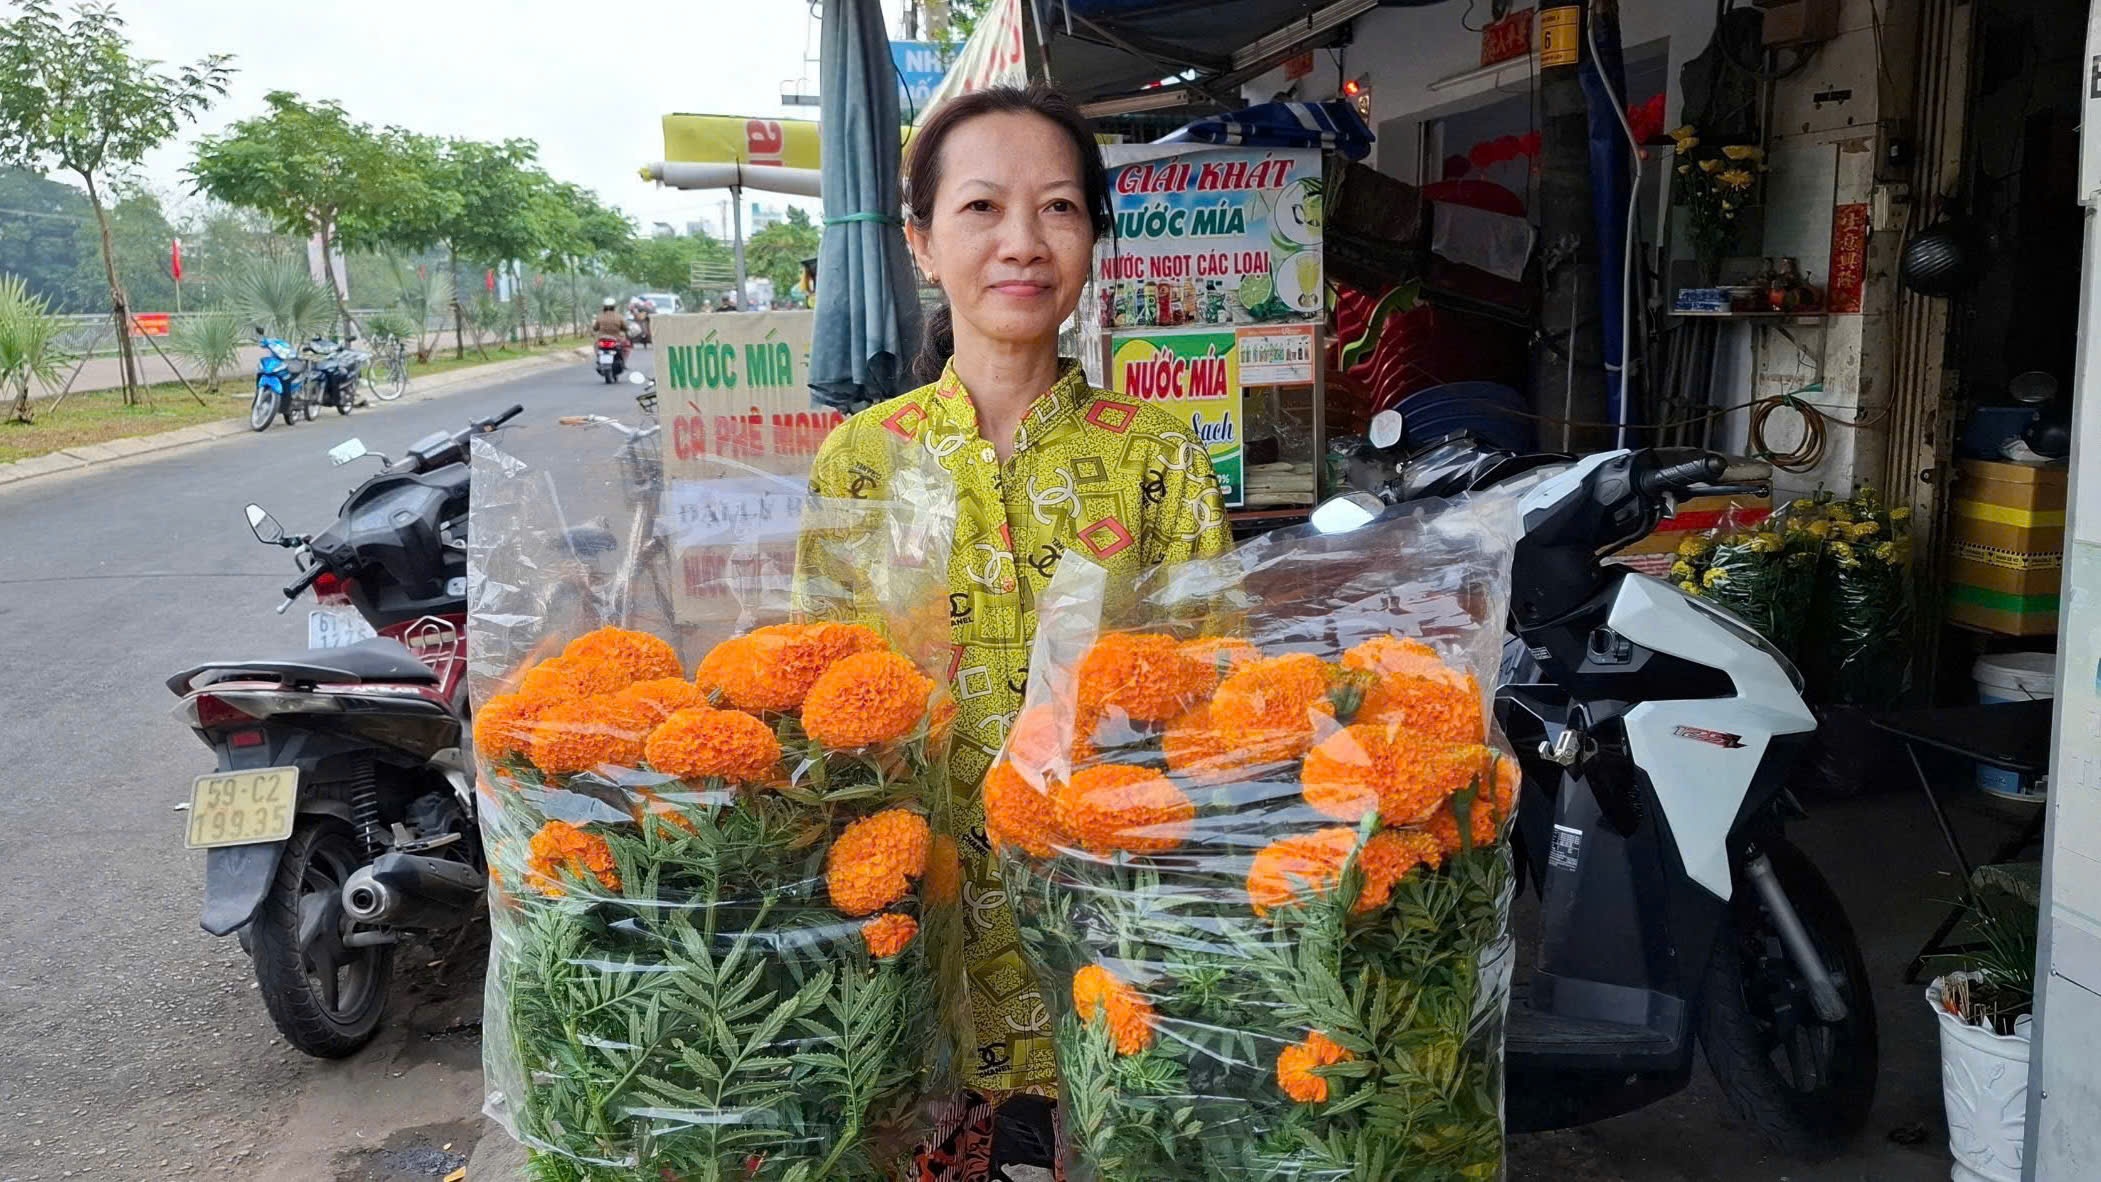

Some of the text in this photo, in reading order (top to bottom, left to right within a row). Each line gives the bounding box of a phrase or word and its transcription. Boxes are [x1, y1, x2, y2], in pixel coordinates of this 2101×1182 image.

[1544, 31, 1552, 49] 6
[1198, 147, 1295, 191] KHÁT
[1190, 200, 1246, 235] MÍA
[1101, 252, 1144, 280] NƯỚC
[1197, 248, 1228, 275] CÁC
[667, 327, 793, 389] NƯỚC MÍA
[1125, 346, 1228, 399] NƯỚC MÍA
[673, 400, 706, 460] CÀ
[208, 774, 281, 808] 59-C2
[194, 804, 288, 841] 199.35
[979, 1064, 1012, 1078] CHANEL
